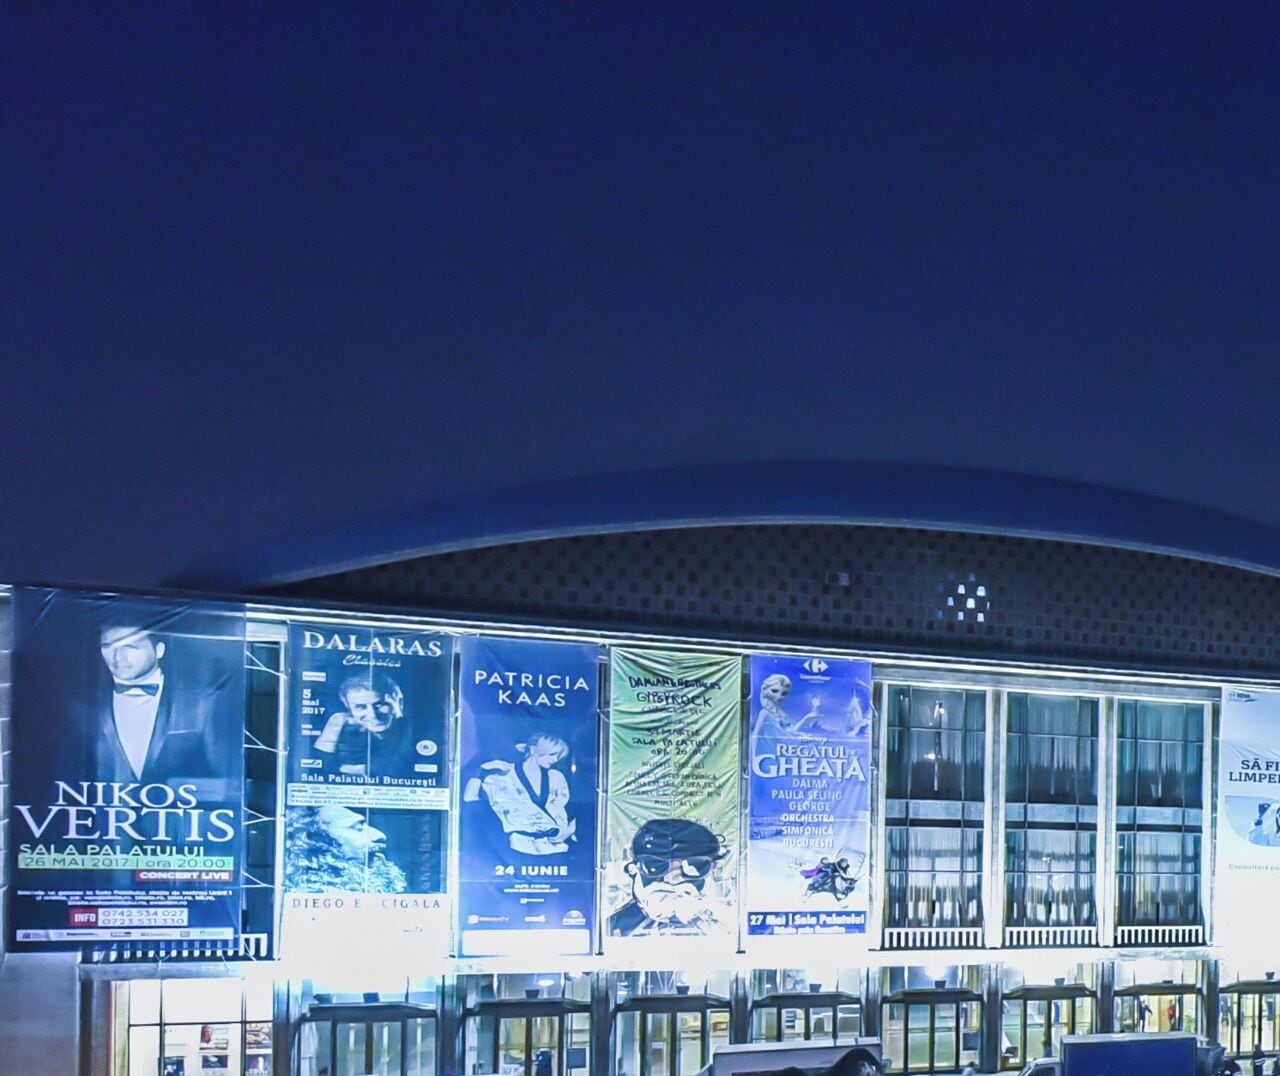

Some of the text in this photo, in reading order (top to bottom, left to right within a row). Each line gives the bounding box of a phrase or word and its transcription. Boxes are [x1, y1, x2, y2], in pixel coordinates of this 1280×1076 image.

[303, 631, 442, 657] DALARAS
[474, 669, 590, 692] PATRICIA
[303, 689, 312, 699] 5
[498, 689, 566, 707] KAAS
[302, 707, 326, 715] 2017
[776, 743, 849, 758] REGATUL
[1241, 757, 1262, 771] SĂ
[301, 773, 324, 782] Sala
[328, 774, 380, 784] Palatului
[792, 778, 828, 788] DALMA
[55, 781, 197, 808] NIKOS
[771, 789, 804, 800] PAULA
[789, 801, 831, 812] GEORGE
[782, 812, 835, 823] ORCHESTRA
[14, 805, 235, 842] VERTIS
[20, 844, 204, 857] SALA PALATULUI
[24, 857, 46, 867] 26
[53, 857, 85, 867] MAI
[92, 857, 129, 868] 2017
[146, 859, 171, 868] ora
[139, 870, 230, 880] CONCERT LIVE
[495, 865, 569, 876] 24 IUNIE
[292, 898, 345, 909] DIEGO
[74, 913, 96, 923] INFO
[750, 914, 764, 926] 27
